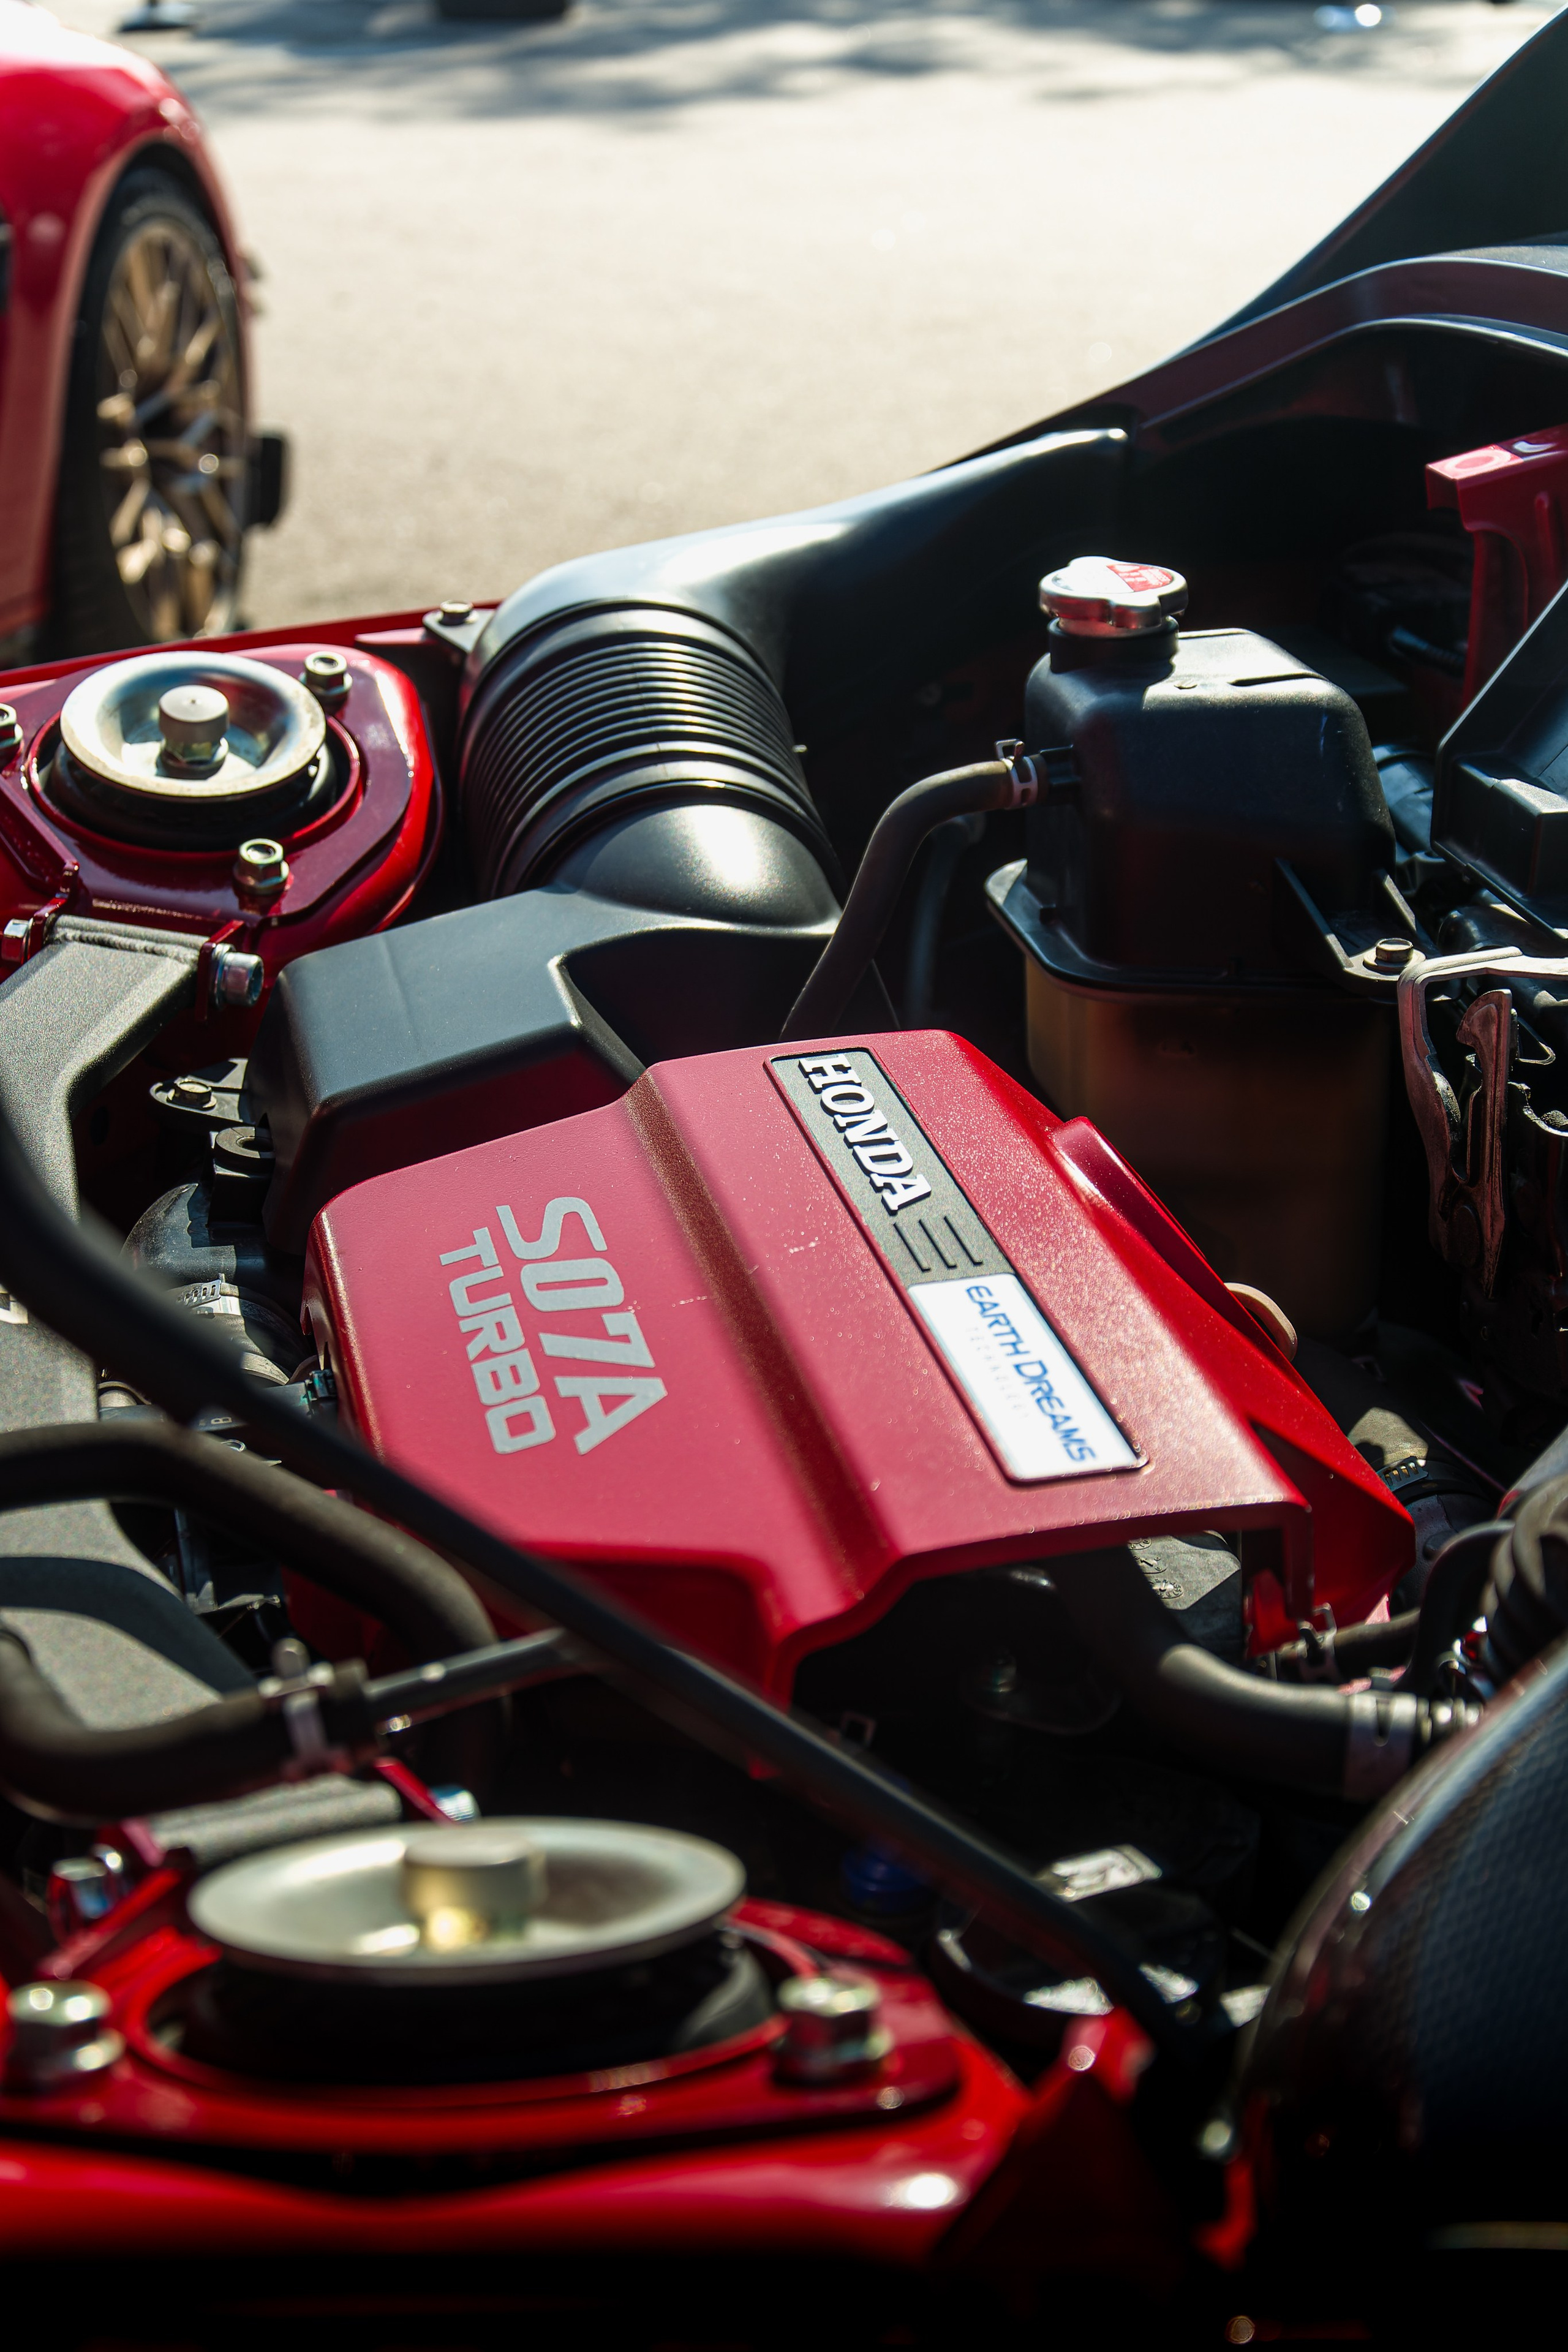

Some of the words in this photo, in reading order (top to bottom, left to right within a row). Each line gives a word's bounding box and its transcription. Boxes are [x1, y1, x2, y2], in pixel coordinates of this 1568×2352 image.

[800, 1054, 932, 1213] HONDA
[439, 1226, 557, 1455] TURBO
[496, 1196, 668, 1455] S07A
[965, 1284, 1030, 1357] EARTH
[1012, 1359, 1097, 1463] DREAMS
